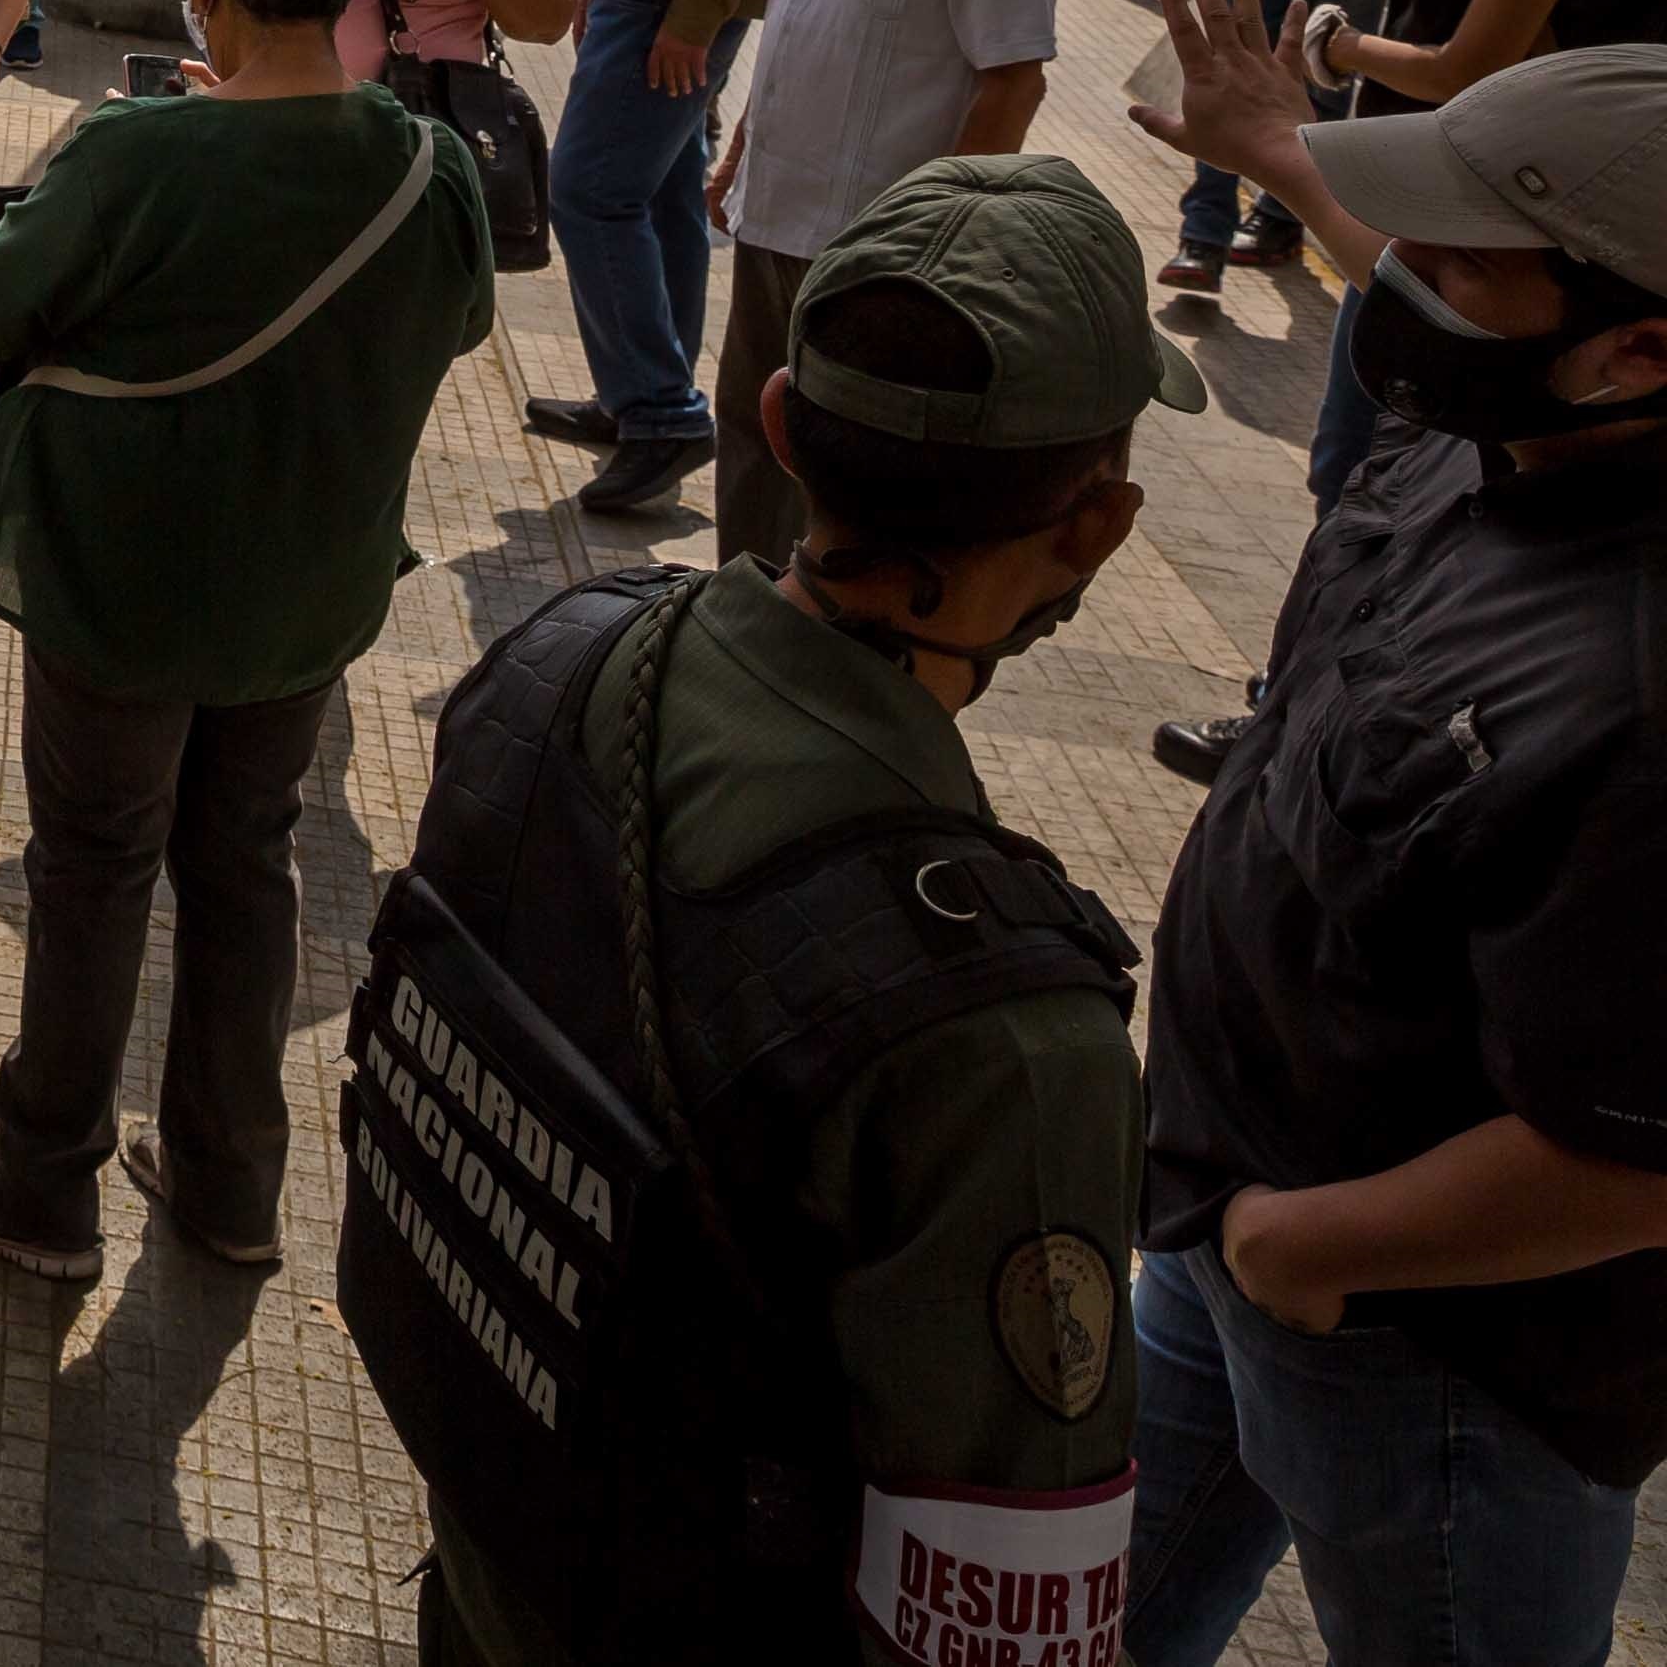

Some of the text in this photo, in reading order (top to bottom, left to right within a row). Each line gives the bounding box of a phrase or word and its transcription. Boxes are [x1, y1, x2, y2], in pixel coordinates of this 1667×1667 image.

[366, 1029, 583, 1330] NACIONAL
[390, 973, 614, 1244] GUARDIA
[356, 1115, 559, 1431] BOLIVARIANA
[895, 1595, 932, 1662] CZ
[899, 1529, 1130, 1635] DESUR TA
